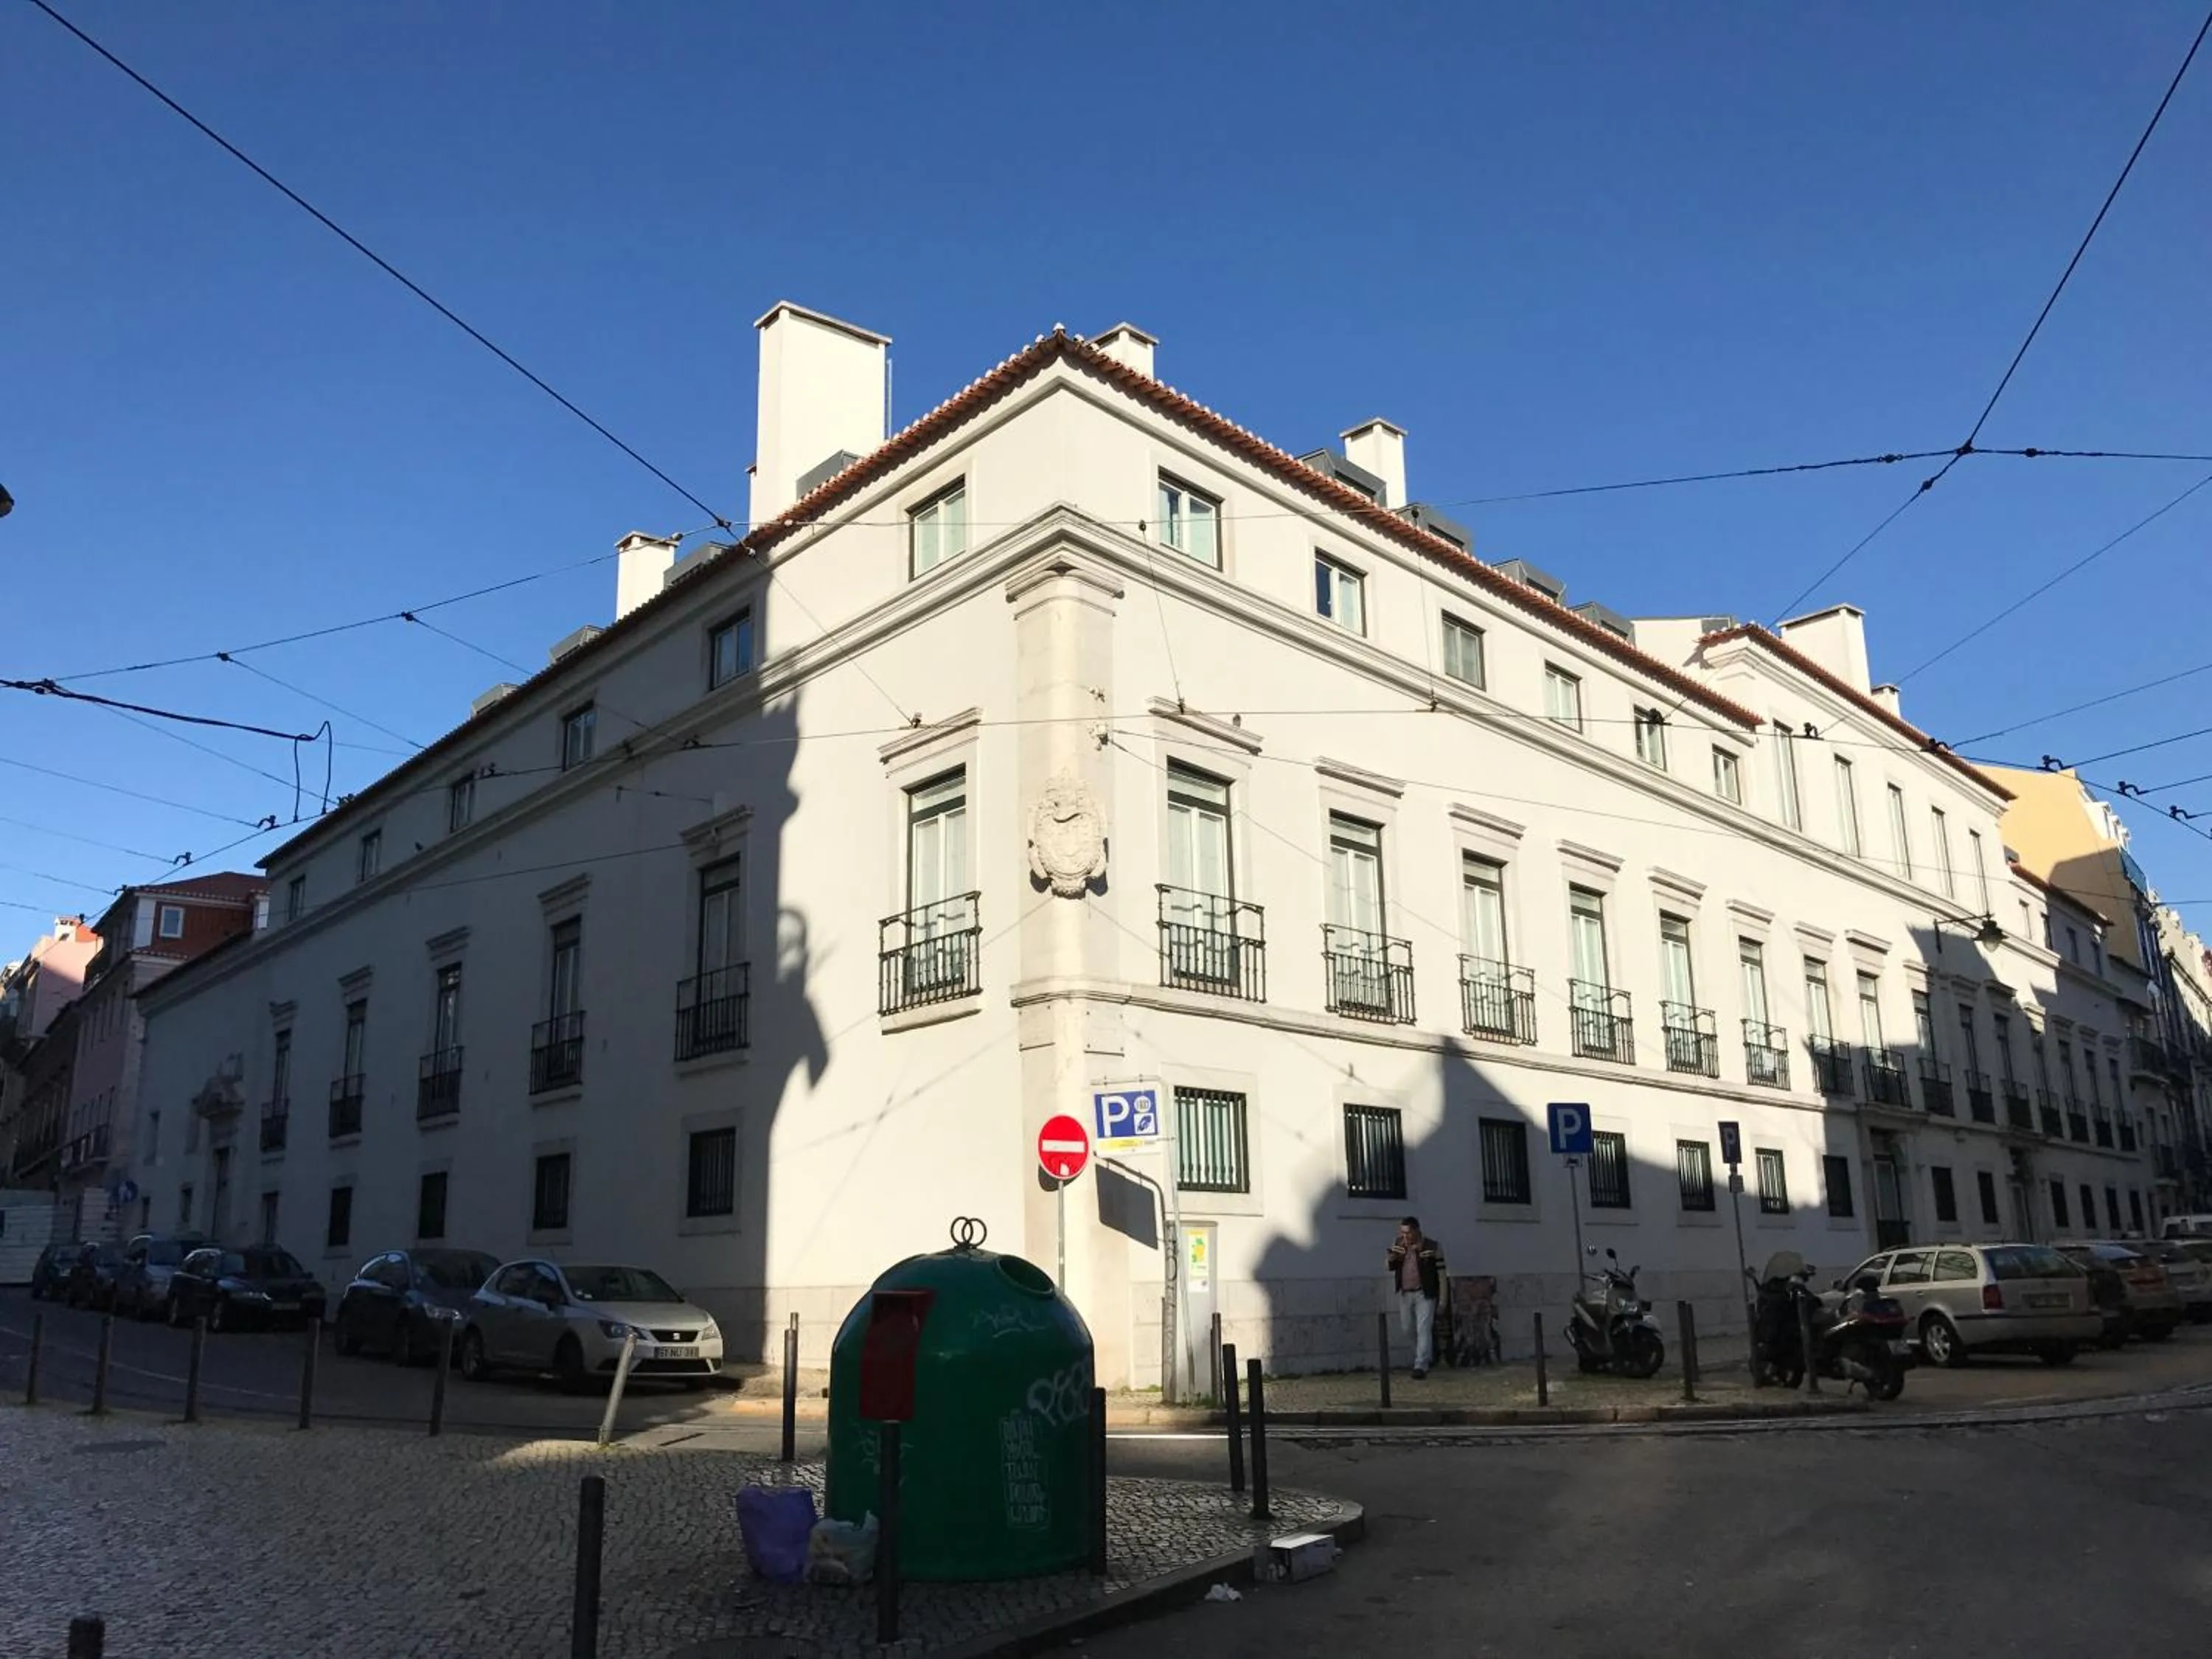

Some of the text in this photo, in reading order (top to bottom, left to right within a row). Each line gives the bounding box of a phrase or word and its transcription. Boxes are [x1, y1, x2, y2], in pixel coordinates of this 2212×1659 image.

[1101, 1094, 1130, 1138] P
[1557, 1108, 1582, 1150] P
[1722, 1127, 1736, 1157] P
